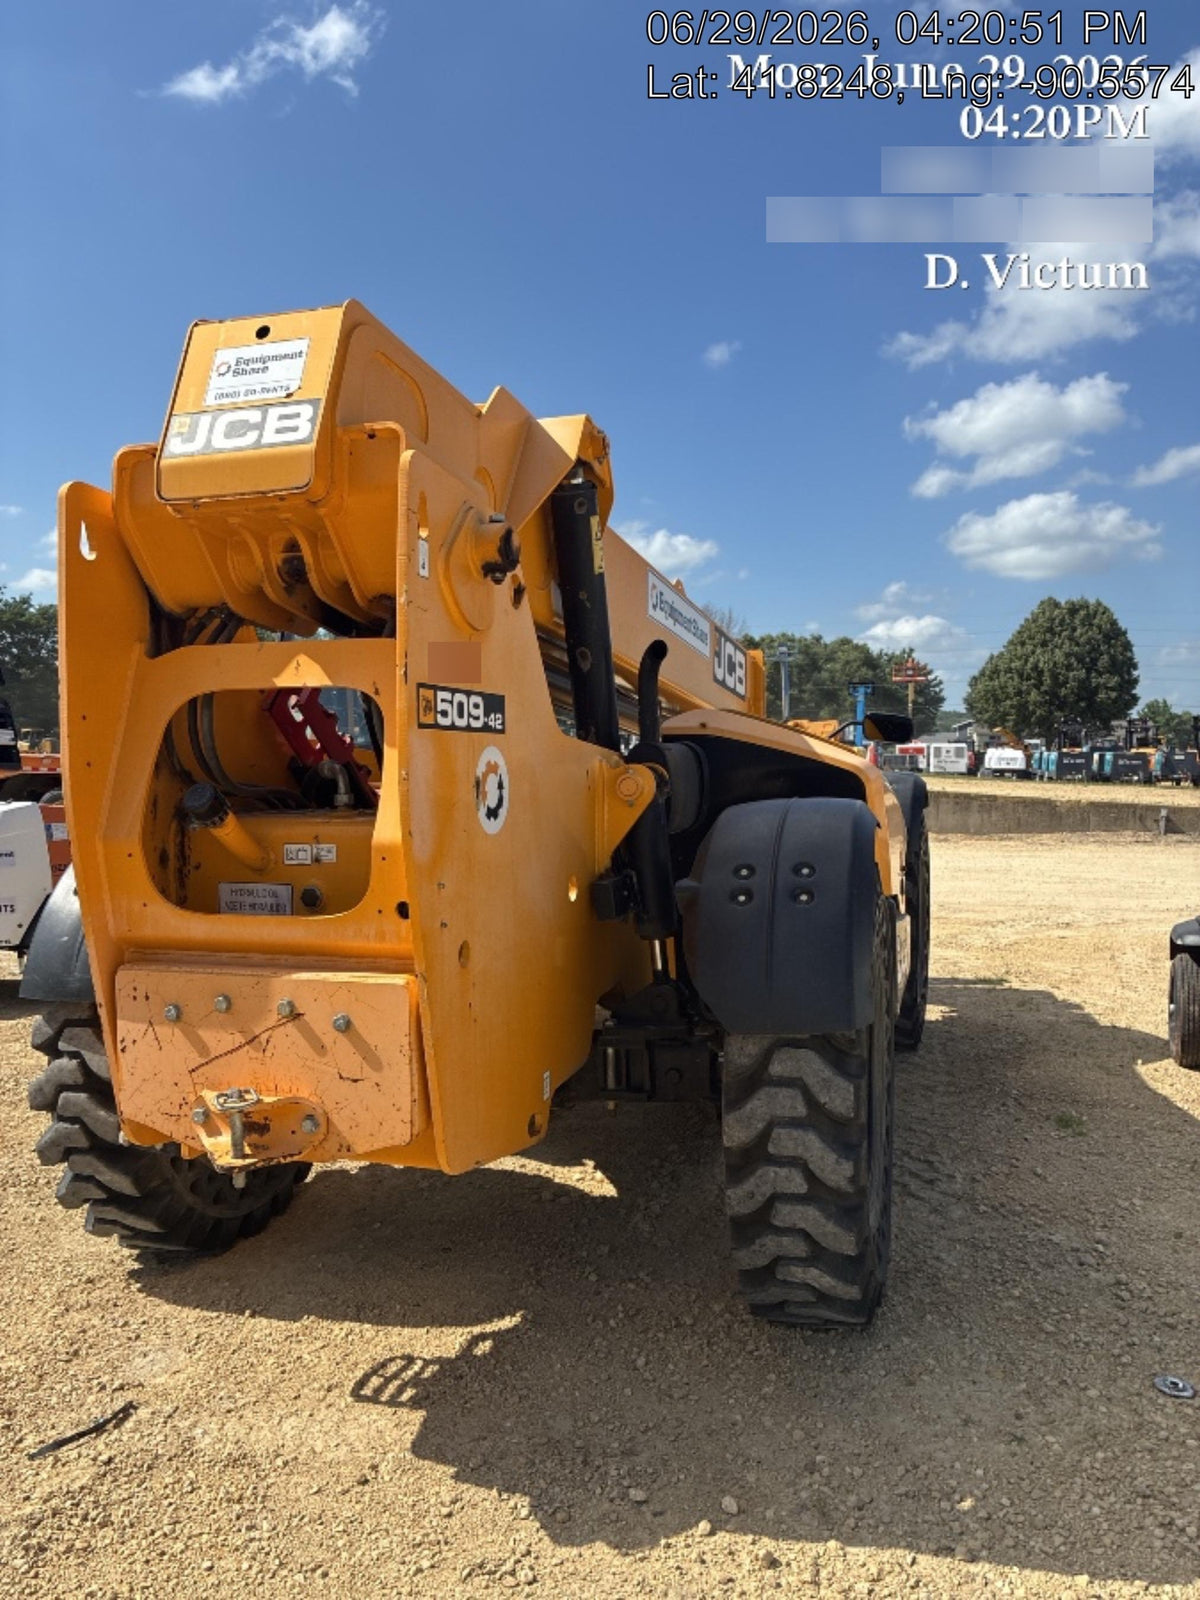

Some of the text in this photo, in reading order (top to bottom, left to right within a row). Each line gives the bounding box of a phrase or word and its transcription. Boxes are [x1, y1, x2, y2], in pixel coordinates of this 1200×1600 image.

[232, 365, 269, 378] Share
[234, 349, 304, 367] Equipment
[169, 403, 314, 454] JCB
[714, 634, 747, 698] JCB
